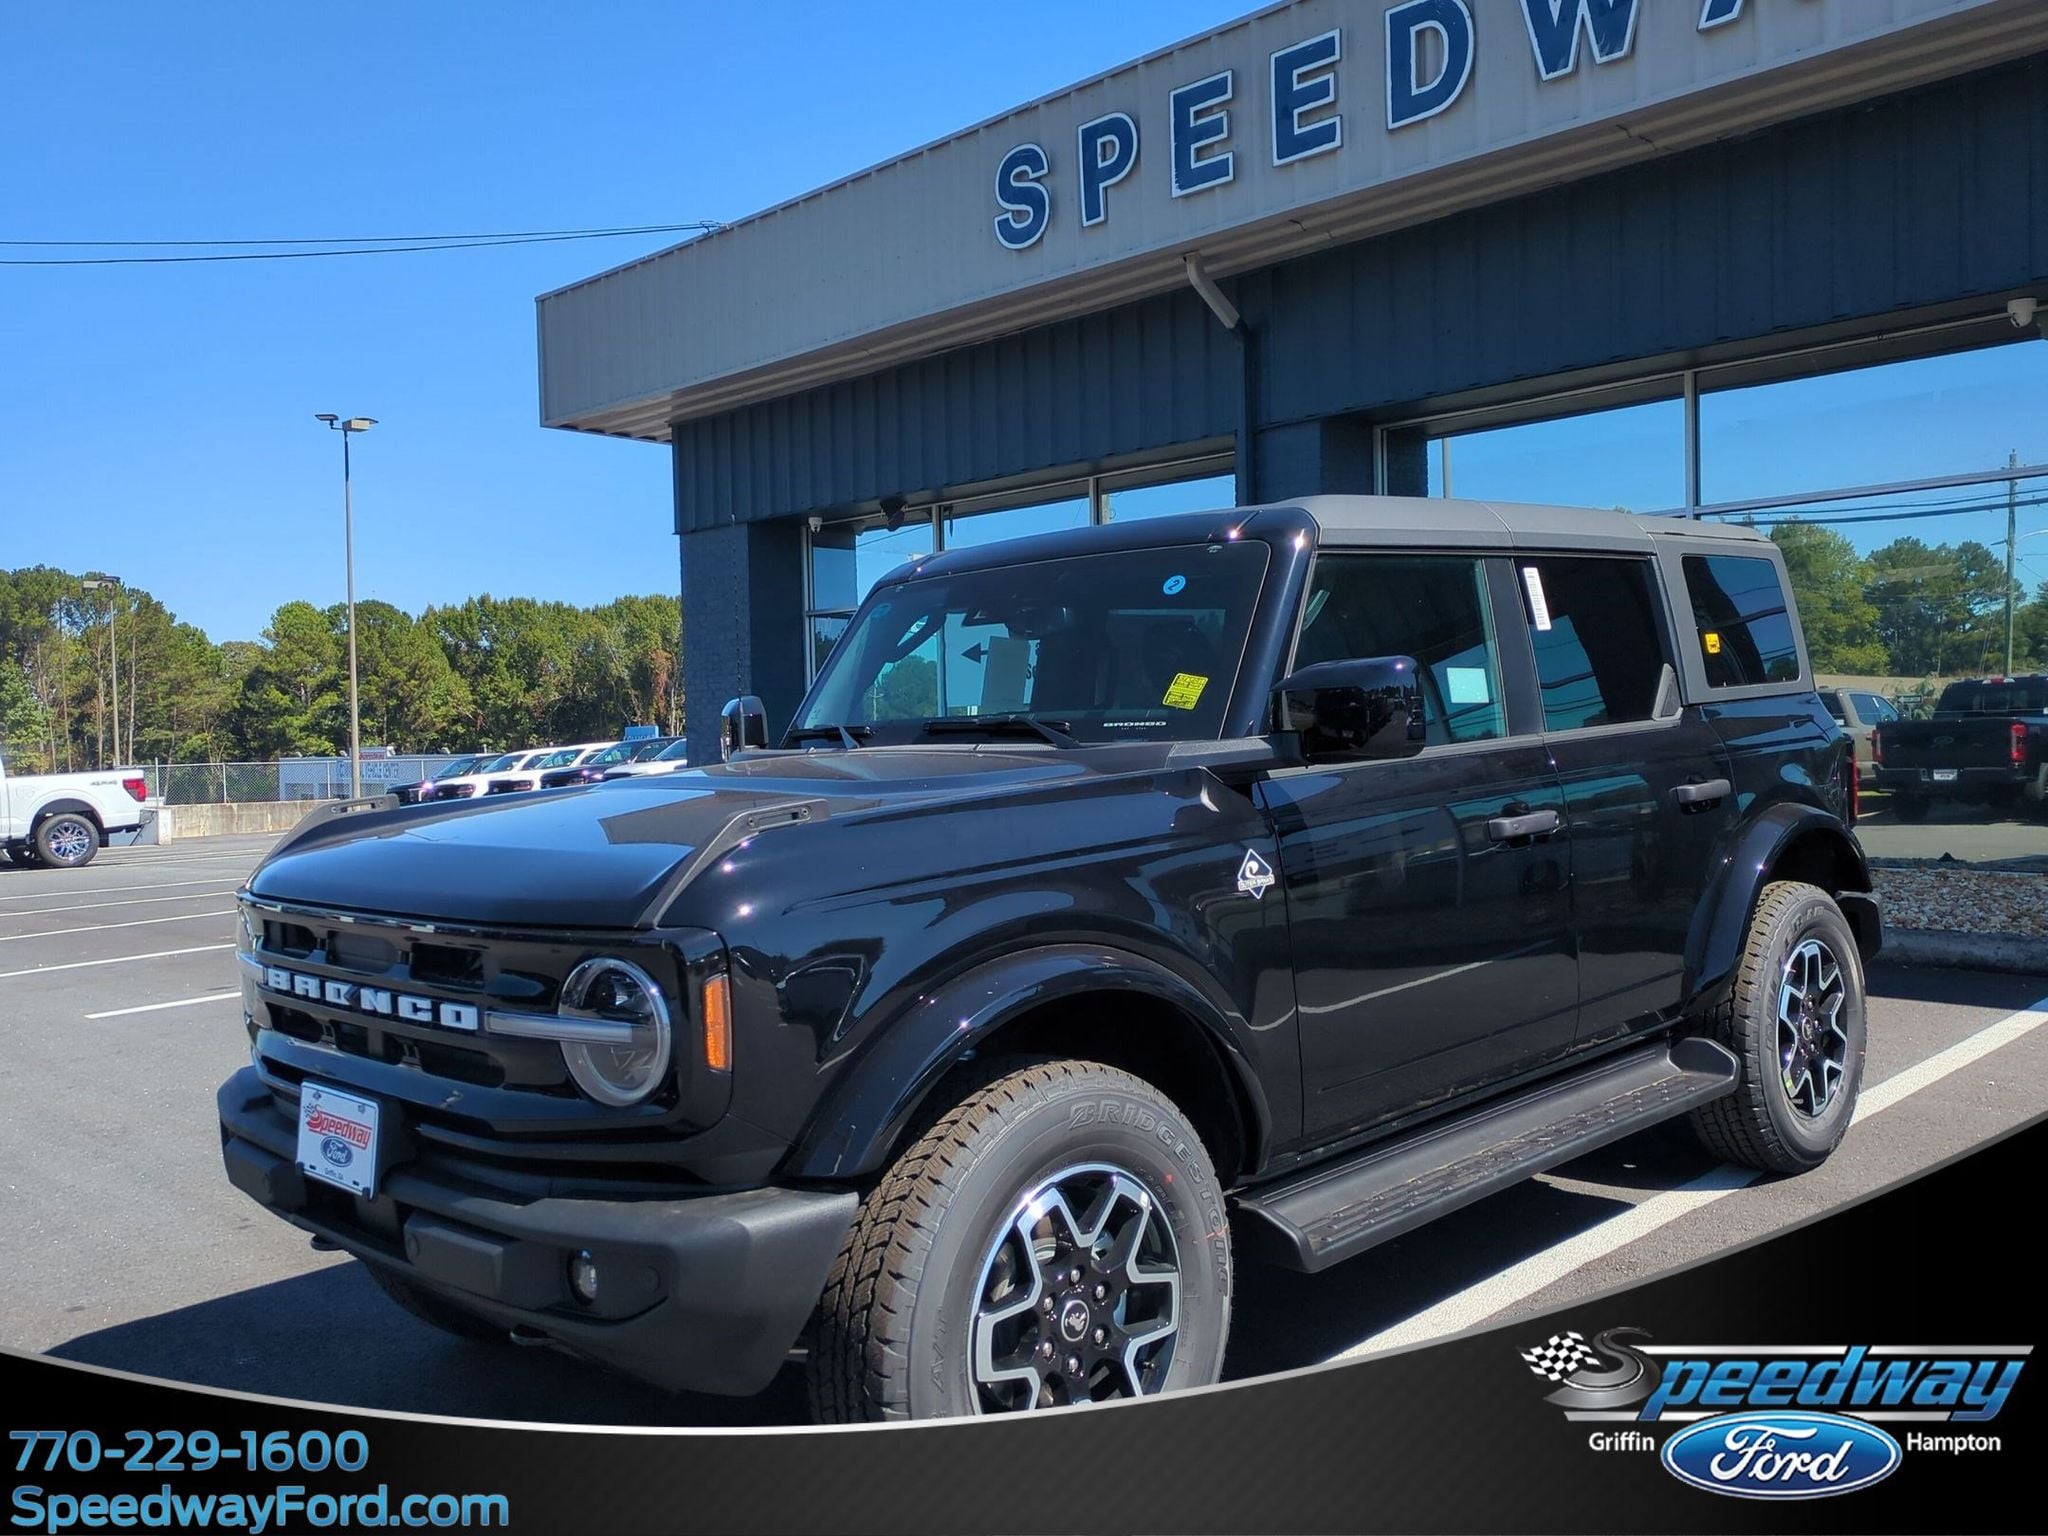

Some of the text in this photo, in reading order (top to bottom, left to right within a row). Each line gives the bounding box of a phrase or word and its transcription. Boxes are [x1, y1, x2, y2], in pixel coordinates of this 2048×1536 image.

[994, 0, 1743, 251] SPEEDW
[1169, 578, 1182, 592] 2
[266, 966, 479, 1031] BRONCO
[306, 1104, 372, 1150] Speedway
[326, 1140, 348, 1162] Ford
